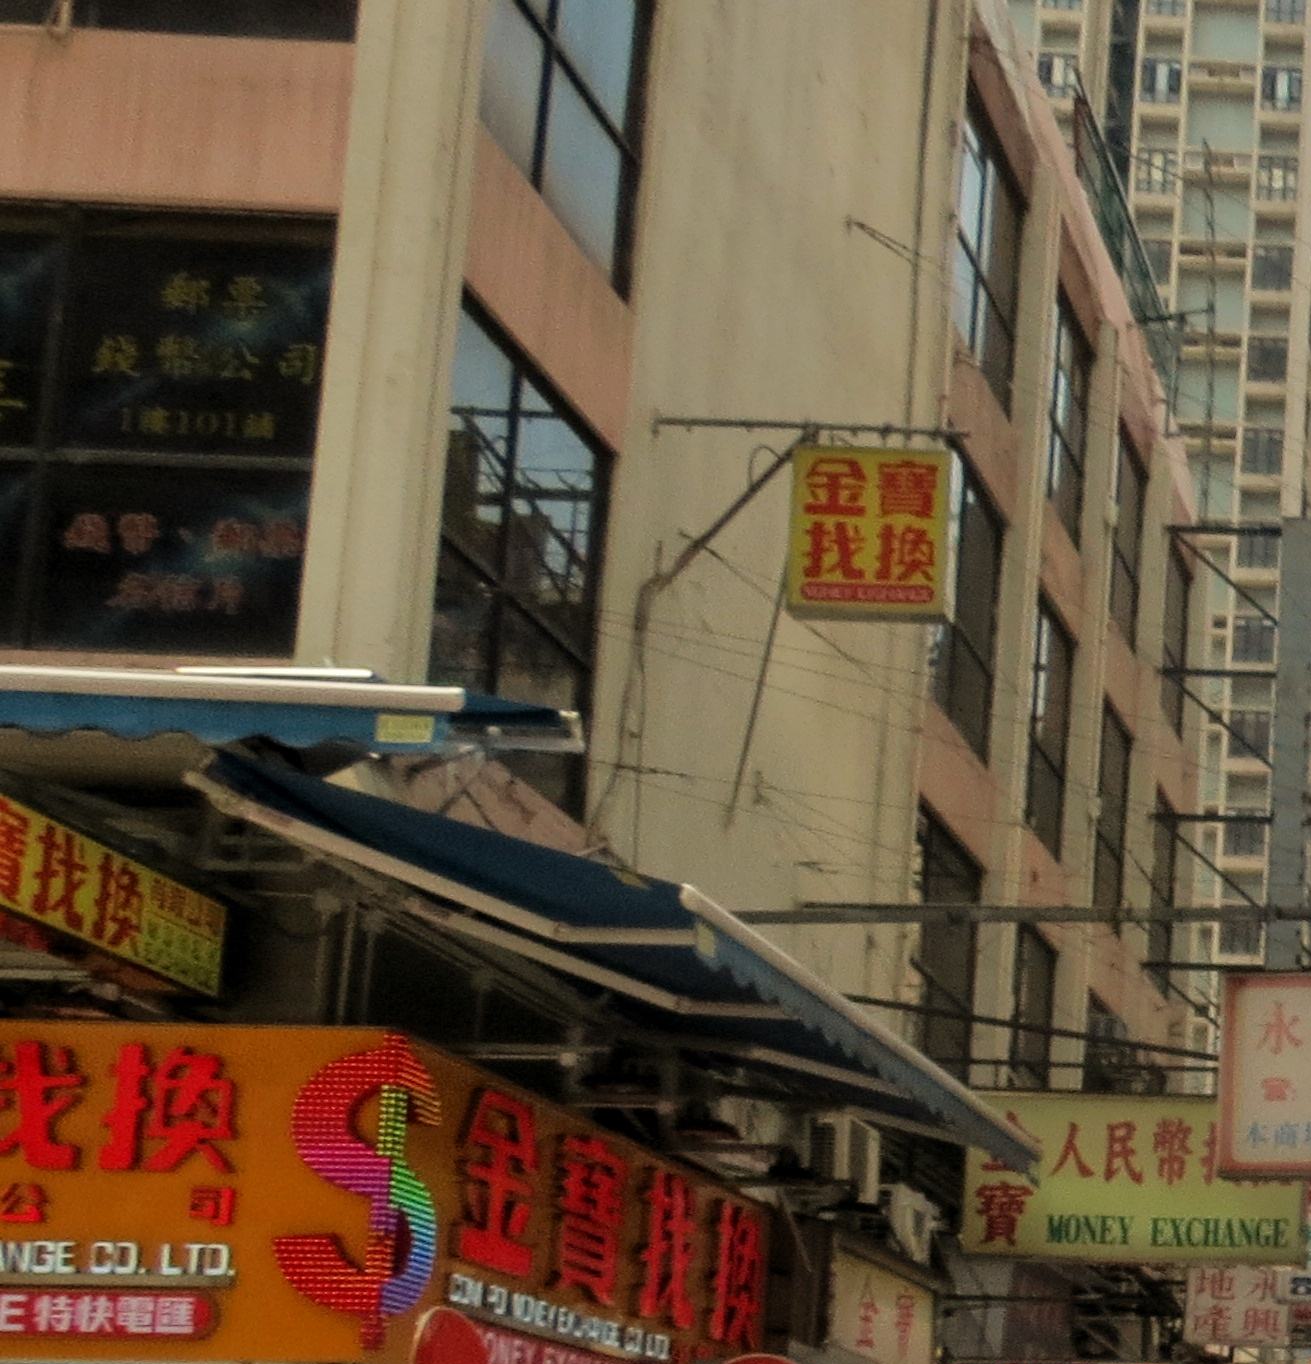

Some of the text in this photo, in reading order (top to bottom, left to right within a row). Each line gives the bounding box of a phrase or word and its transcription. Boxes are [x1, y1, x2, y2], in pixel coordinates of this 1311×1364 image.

[803, 456, 938, 519] 金寶
[803, 521, 936, 583] 找換
[1046, 1214, 1291, 1249] MONEY EXCHANGE
[32, 1295, 197, 1335] 特快電匯
